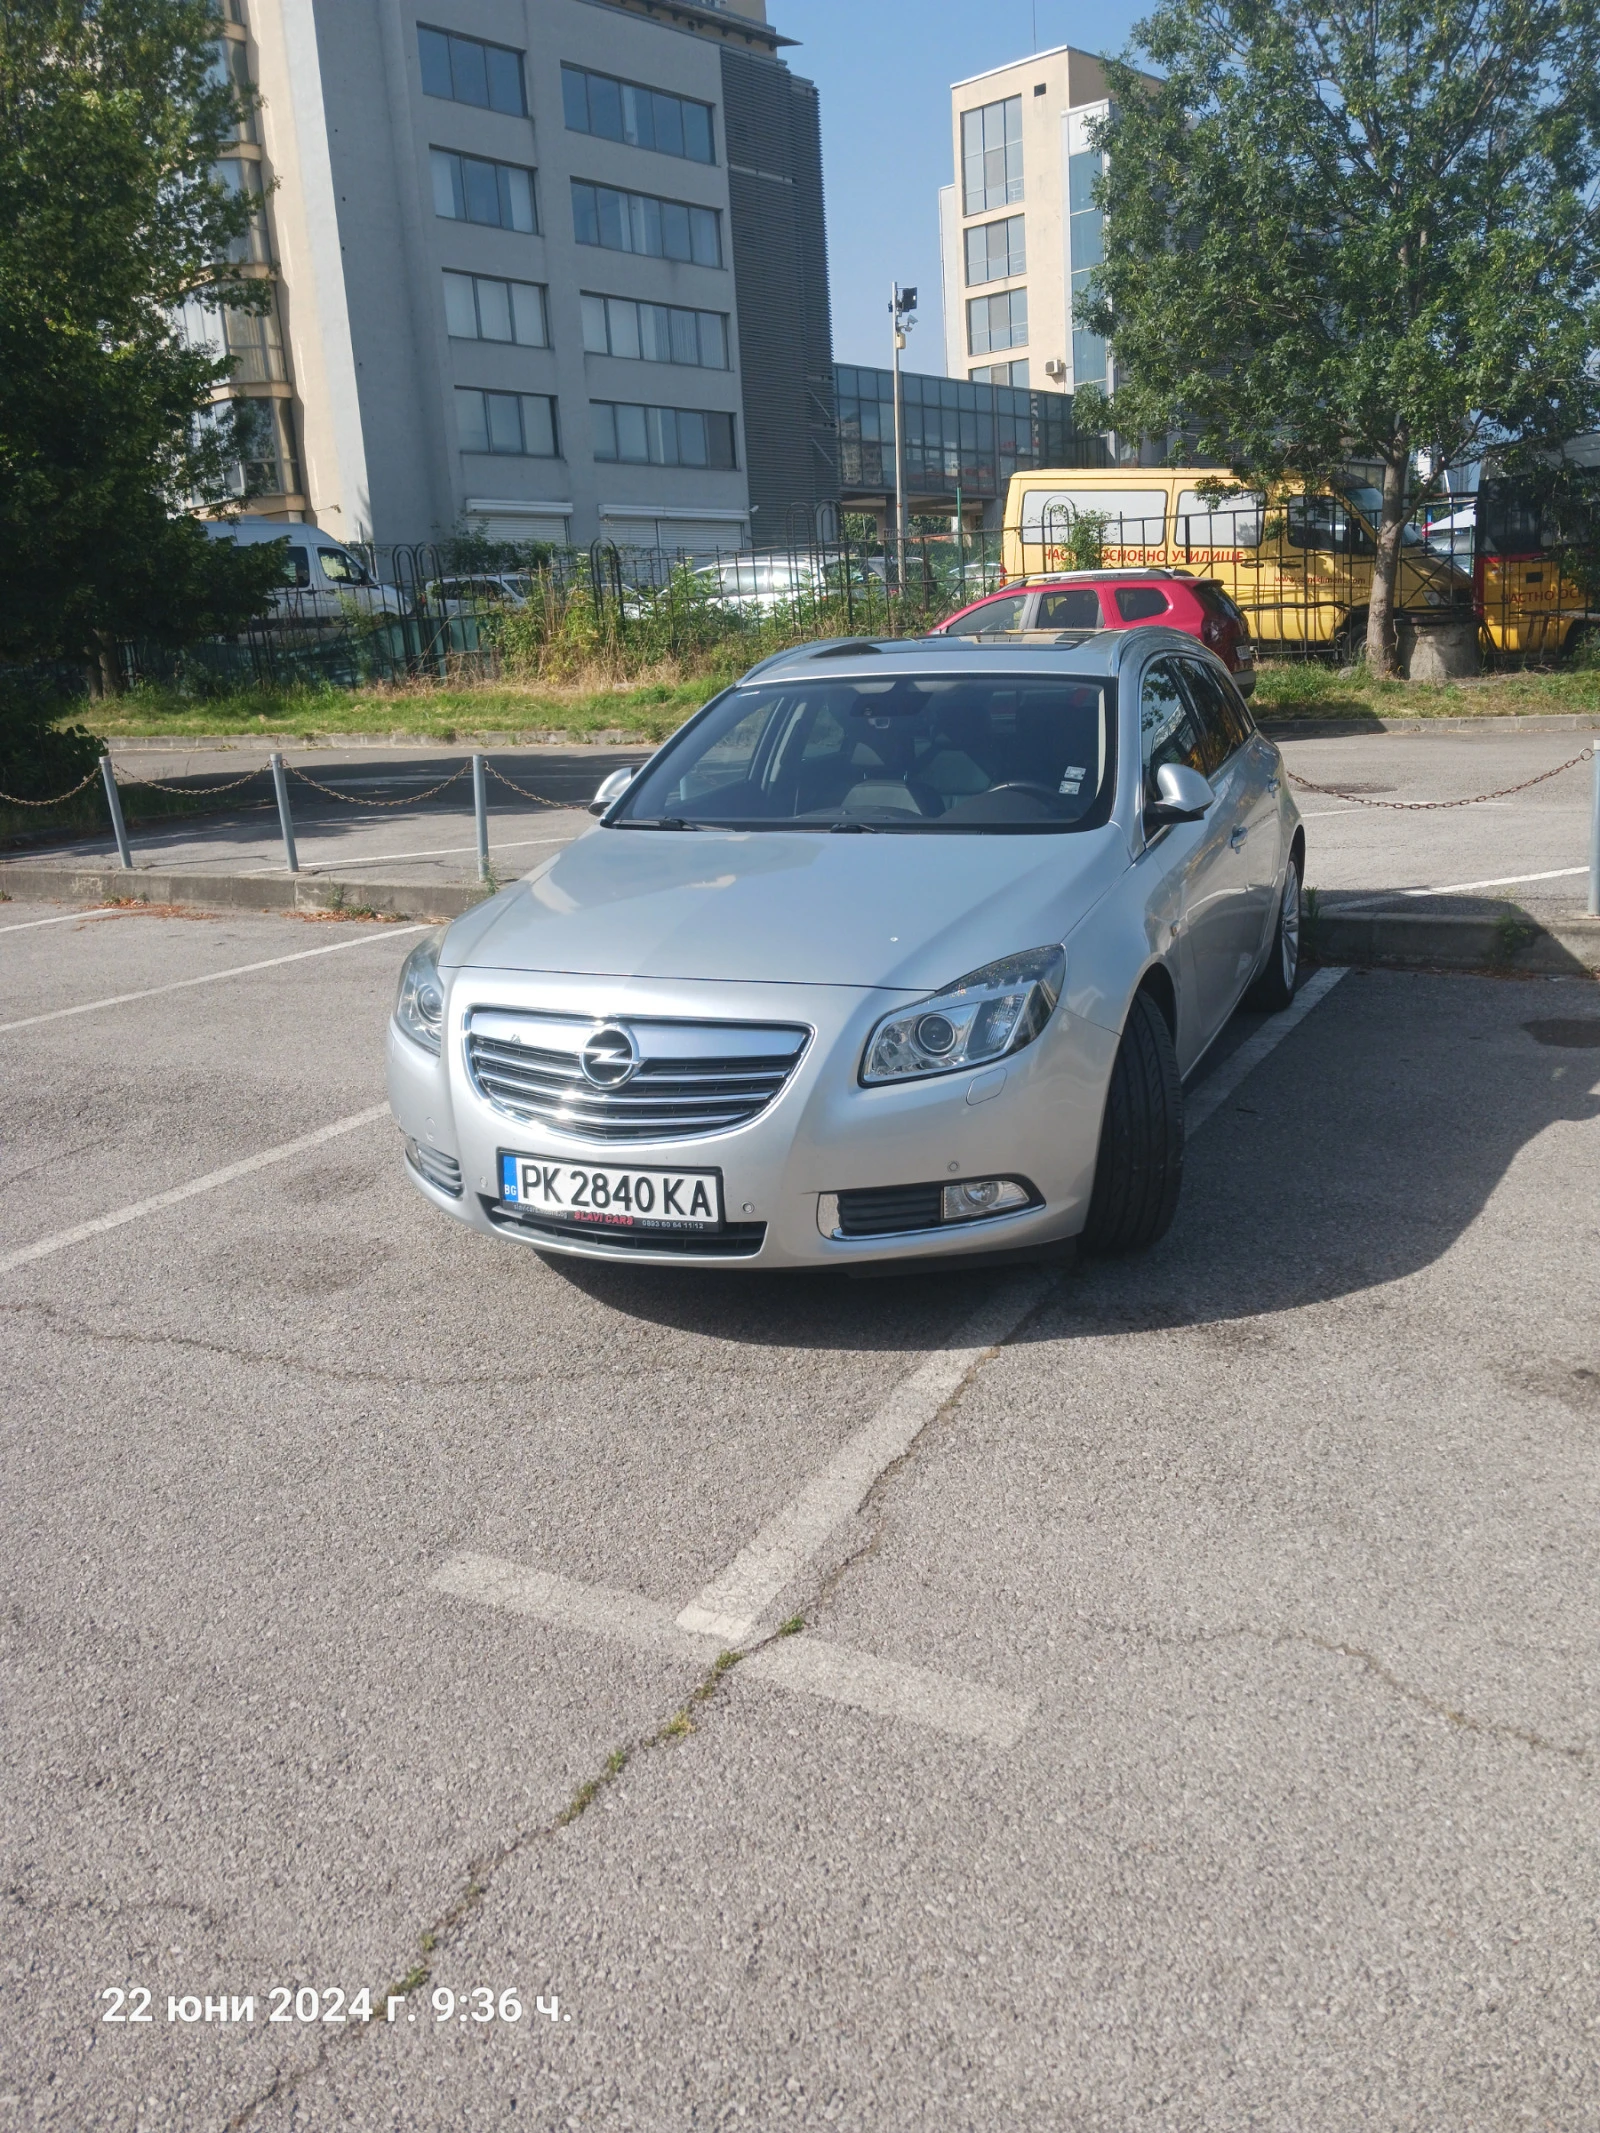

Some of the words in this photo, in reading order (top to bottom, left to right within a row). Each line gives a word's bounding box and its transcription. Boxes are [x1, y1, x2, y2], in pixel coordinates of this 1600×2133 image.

[1101, 549, 1167, 563] ОСНОВНО
[1171, 550, 1244, 565] УЧИЛИЩЕ
[504, 1184, 517, 1196] BG
[521, 1164, 564, 1204] PK
[569, 1170, 655, 1213] 2840
[663, 1177, 712, 1217] KA
[573, 1211, 603, 1223] SLAVI
[604, 1213, 634, 1226] CARS
